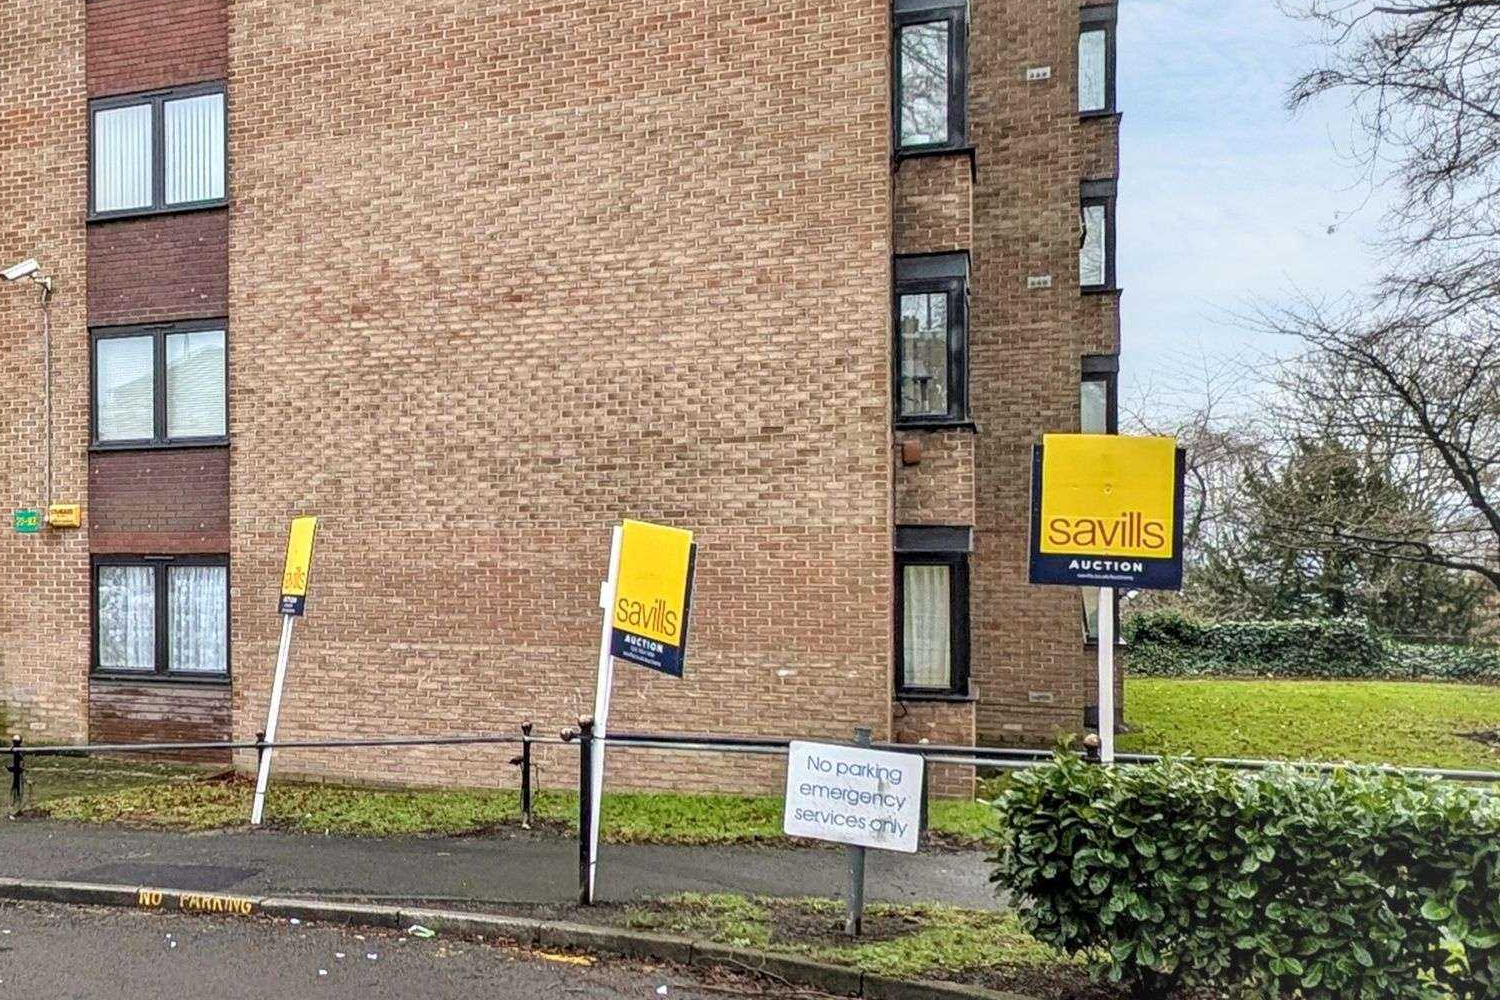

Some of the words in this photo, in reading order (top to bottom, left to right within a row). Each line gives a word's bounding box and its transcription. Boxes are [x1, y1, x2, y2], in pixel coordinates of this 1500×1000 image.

[1048, 511, 1165, 549] savills
[1068, 559, 1143, 573] AUCTION
[616, 598, 677, 637] savills
[623, 633, 664, 654] AUCTION
[806, 755, 832, 772] No
[836, 762, 902, 785] parking
[799, 782, 907, 811] emergency
[794, 807, 866, 830] services
[869, 818, 908, 838] only
[139, 889, 162, 906] NO
[180, 892, 252, 914] PARKING
